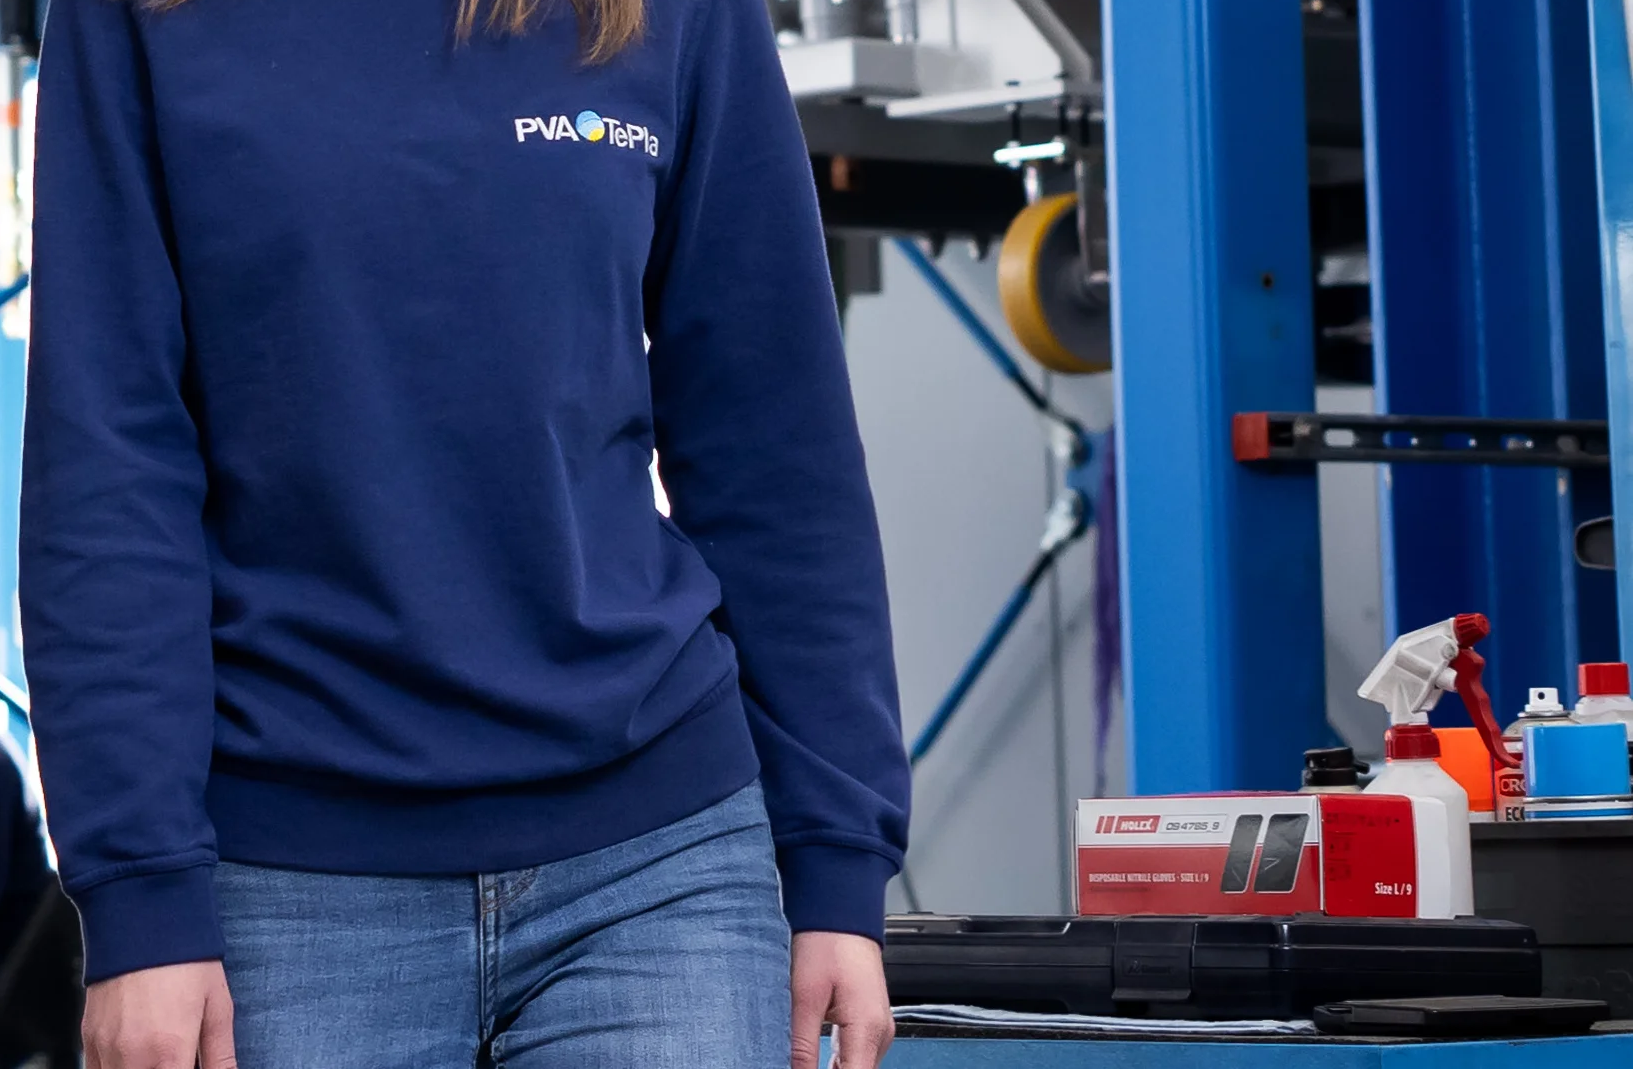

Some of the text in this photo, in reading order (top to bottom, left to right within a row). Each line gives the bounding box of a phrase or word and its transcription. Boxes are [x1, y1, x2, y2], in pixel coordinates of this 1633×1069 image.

[514, 115, 580, 143] PVA
[1120, 818, 1154, 831] HOLEX
[1089, 873, 1126, 883] DISPOSABLE
[1152, 873, 1175, 883] GLOVES
[1374, 882, 1393, 895] Size
